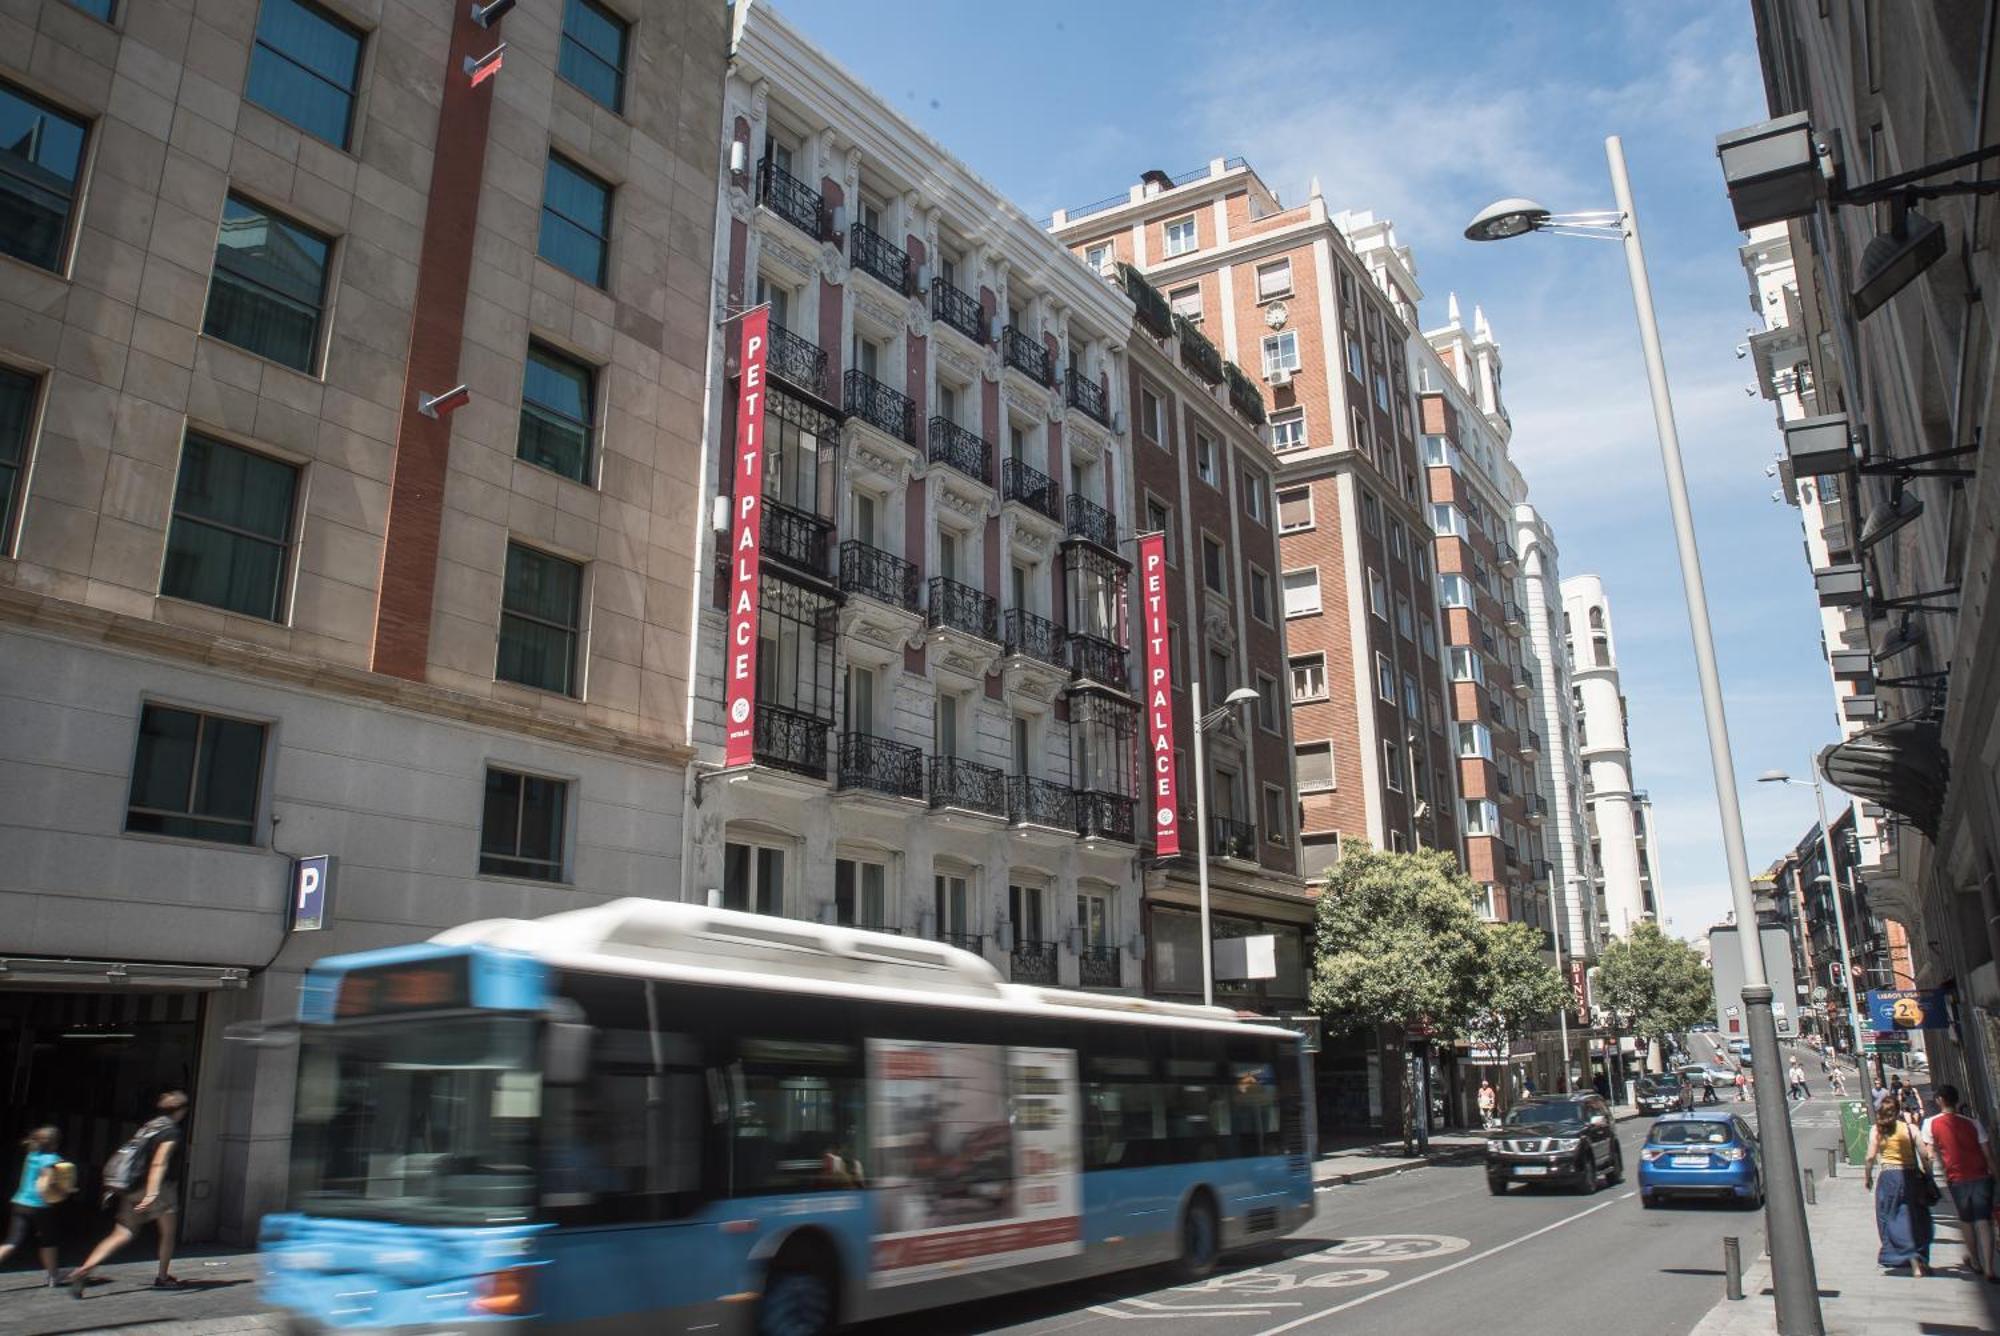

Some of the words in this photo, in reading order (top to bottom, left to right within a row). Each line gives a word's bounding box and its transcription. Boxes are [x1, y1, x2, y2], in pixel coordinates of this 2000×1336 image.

[742, 335, 762, 476] PETIT
[734, 495, 756, 680] PALACE
[1147, 554, 1164, 655] PETIT
[1152, 667, 1170, 796] PALACE
[298, 867, 320, 909] P
